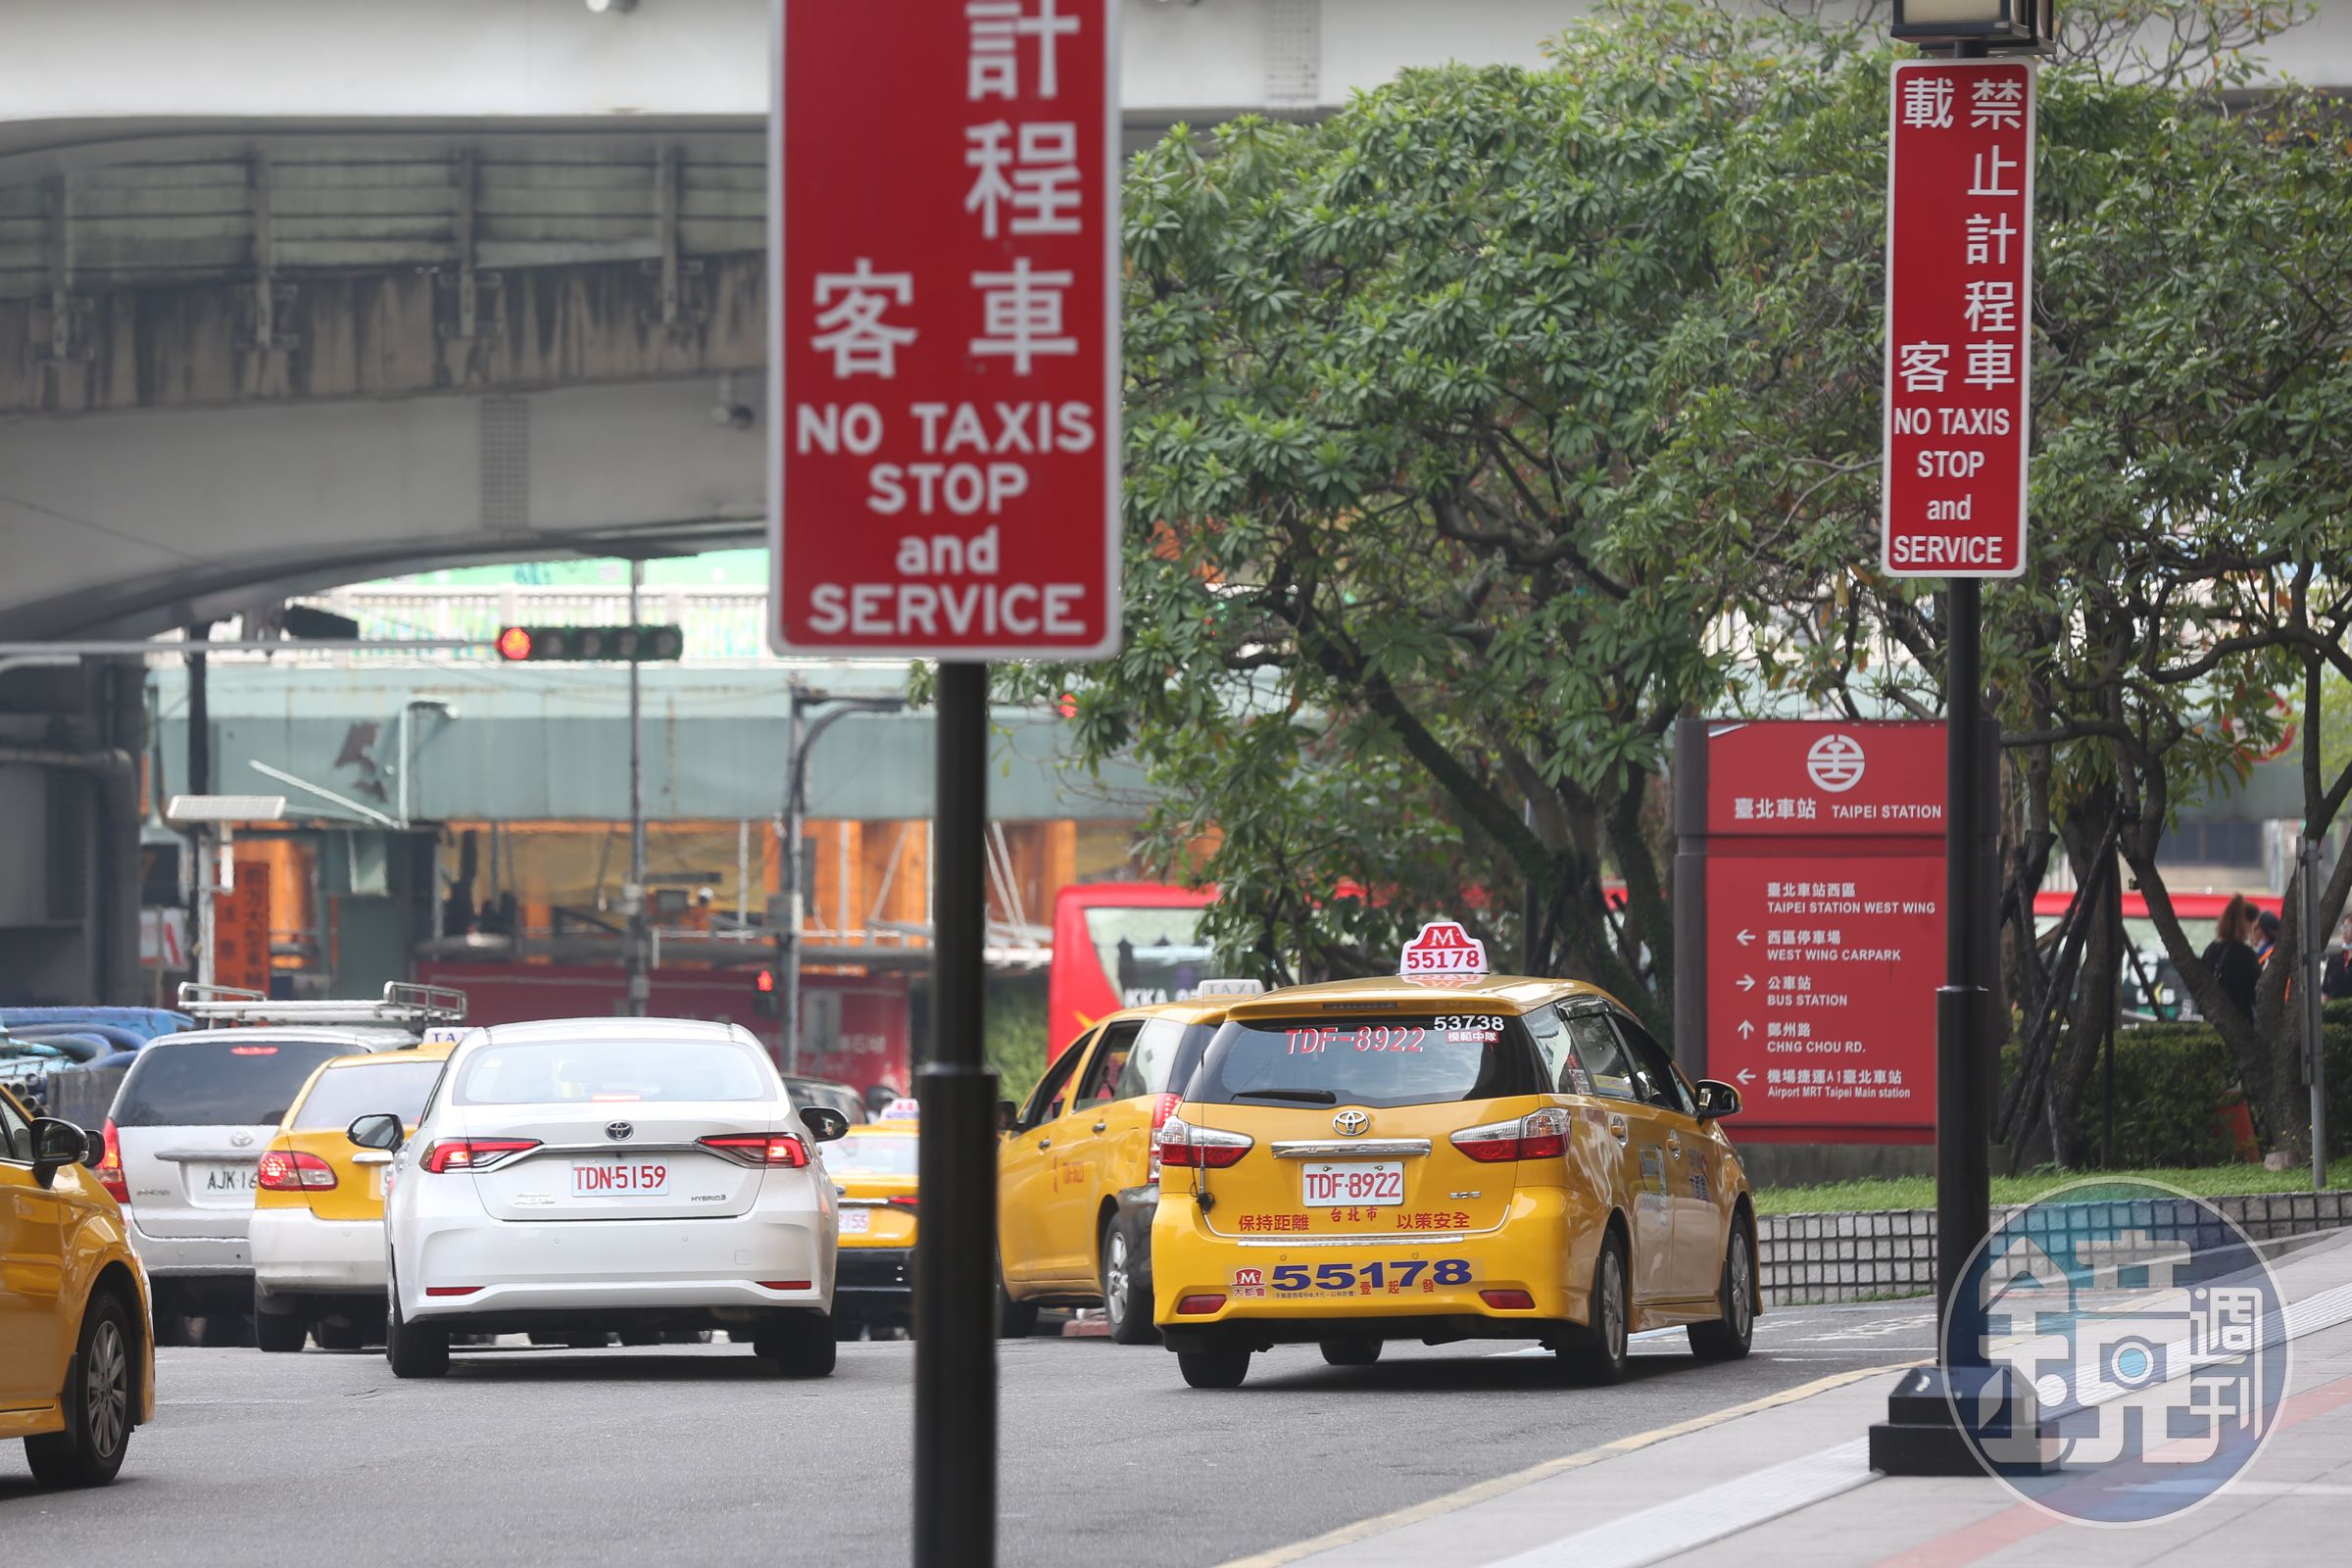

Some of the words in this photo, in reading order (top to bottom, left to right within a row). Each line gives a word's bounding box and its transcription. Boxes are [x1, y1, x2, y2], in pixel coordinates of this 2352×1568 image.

[1964, 78, 2024, 392] 禁止計程車
[797, 403, 883, 455] NO
[911, 402, 1095, 454] TAXIS
[1894, 408, 1931, 435] NO
[1938, 409, 2010, 435] TAXIS
[1918, 451, 1984, 478] STOP
[867, 464, 1027, 514] STOP
[1927, 494, 1972, 520] and
[897, 526, 999, 575] and
[1894, 536, 2002, 564] SERVICE
[807, 584, 1086, 634] SERVICE
[1735, 798, 1816, 819] 臺北車站
[1832, 806, 1877, 818] TAIPEI
[1882, 805, 1941, 818] STATION
[1768, 902, 1806, 913] TAIPEI
[1810, 902, 1860, 913] STATION
[1865, 902, 1898, 913] WEST
[1902, 902, 1936, 913] WING
[1407, 951, 1479, 968] 55178
[1768, 949, 1802, 961] WEST
[1806, 949, 1838, 961] WING
[1841, 949, 1900, 961] CARPARK
[1207, 984, 1257, 995] TAXI
[1768, 976, 1811, 991] 公車站
[1768, 994, 1792, 1006] BUS
[1797, 994, 1847, 1005] STATION
[1434, 1015, 1504, 1032] 53738
[1286, 1026, 1426, 1054] TDF-8922
[1768, 1041, 1802, 1053] CHNG
[1806, 1041, 1841, 1053] CHOU
[1845, 1042, 1866, 1053] RD.
[1768, 1086, 1800, 1100] Airport
[1802, 1086, 1822, 1098] MRT
[1826, 1086, 1852, 1100] Taipei
[1855, 1086, 1876, 1098] Main
[1879, 1087, 1910, 1098] station
[1239, 1214, 1309, 1231] 保持距離
[1396, 1212, 1470, 1229] 以策安全
[1330, 1206, 1379, 1222] 台北市
[1271, 1259, 1472, 1291] 55178
